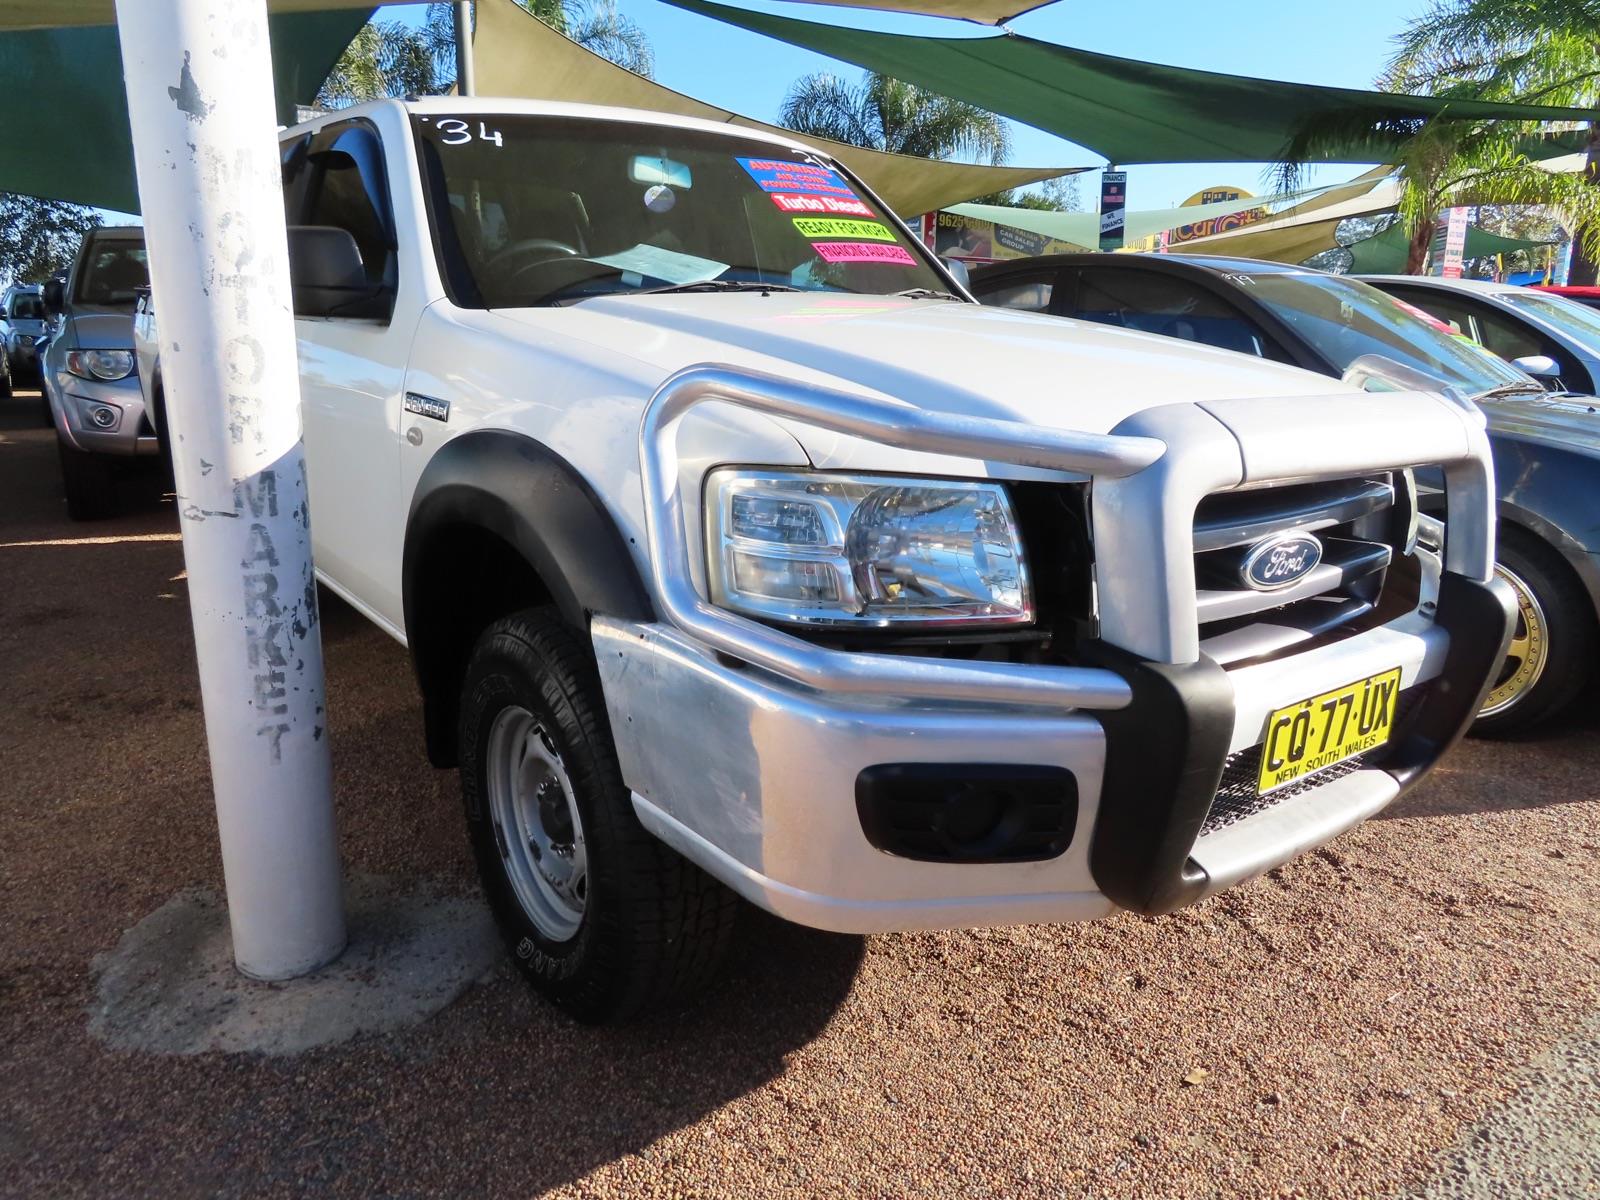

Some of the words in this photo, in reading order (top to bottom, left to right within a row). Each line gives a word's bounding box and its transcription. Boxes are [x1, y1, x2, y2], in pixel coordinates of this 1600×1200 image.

[436, 119, 503, 147] 34
[774, 195, 825, 211] Turbo
[821, 197, 870, 215] Diesel
[797, 221, 838, 234] READY
[834, 222, 863, 235] FOR
[1264, 545, 1308, 579] Ford
[231, 469, 289, 766] MARKET
[1274, 765, 1300, 786] NEW
[1305, 749, 1340, 773] SOUTH
[1344, 734, 1377, 756] WALES
